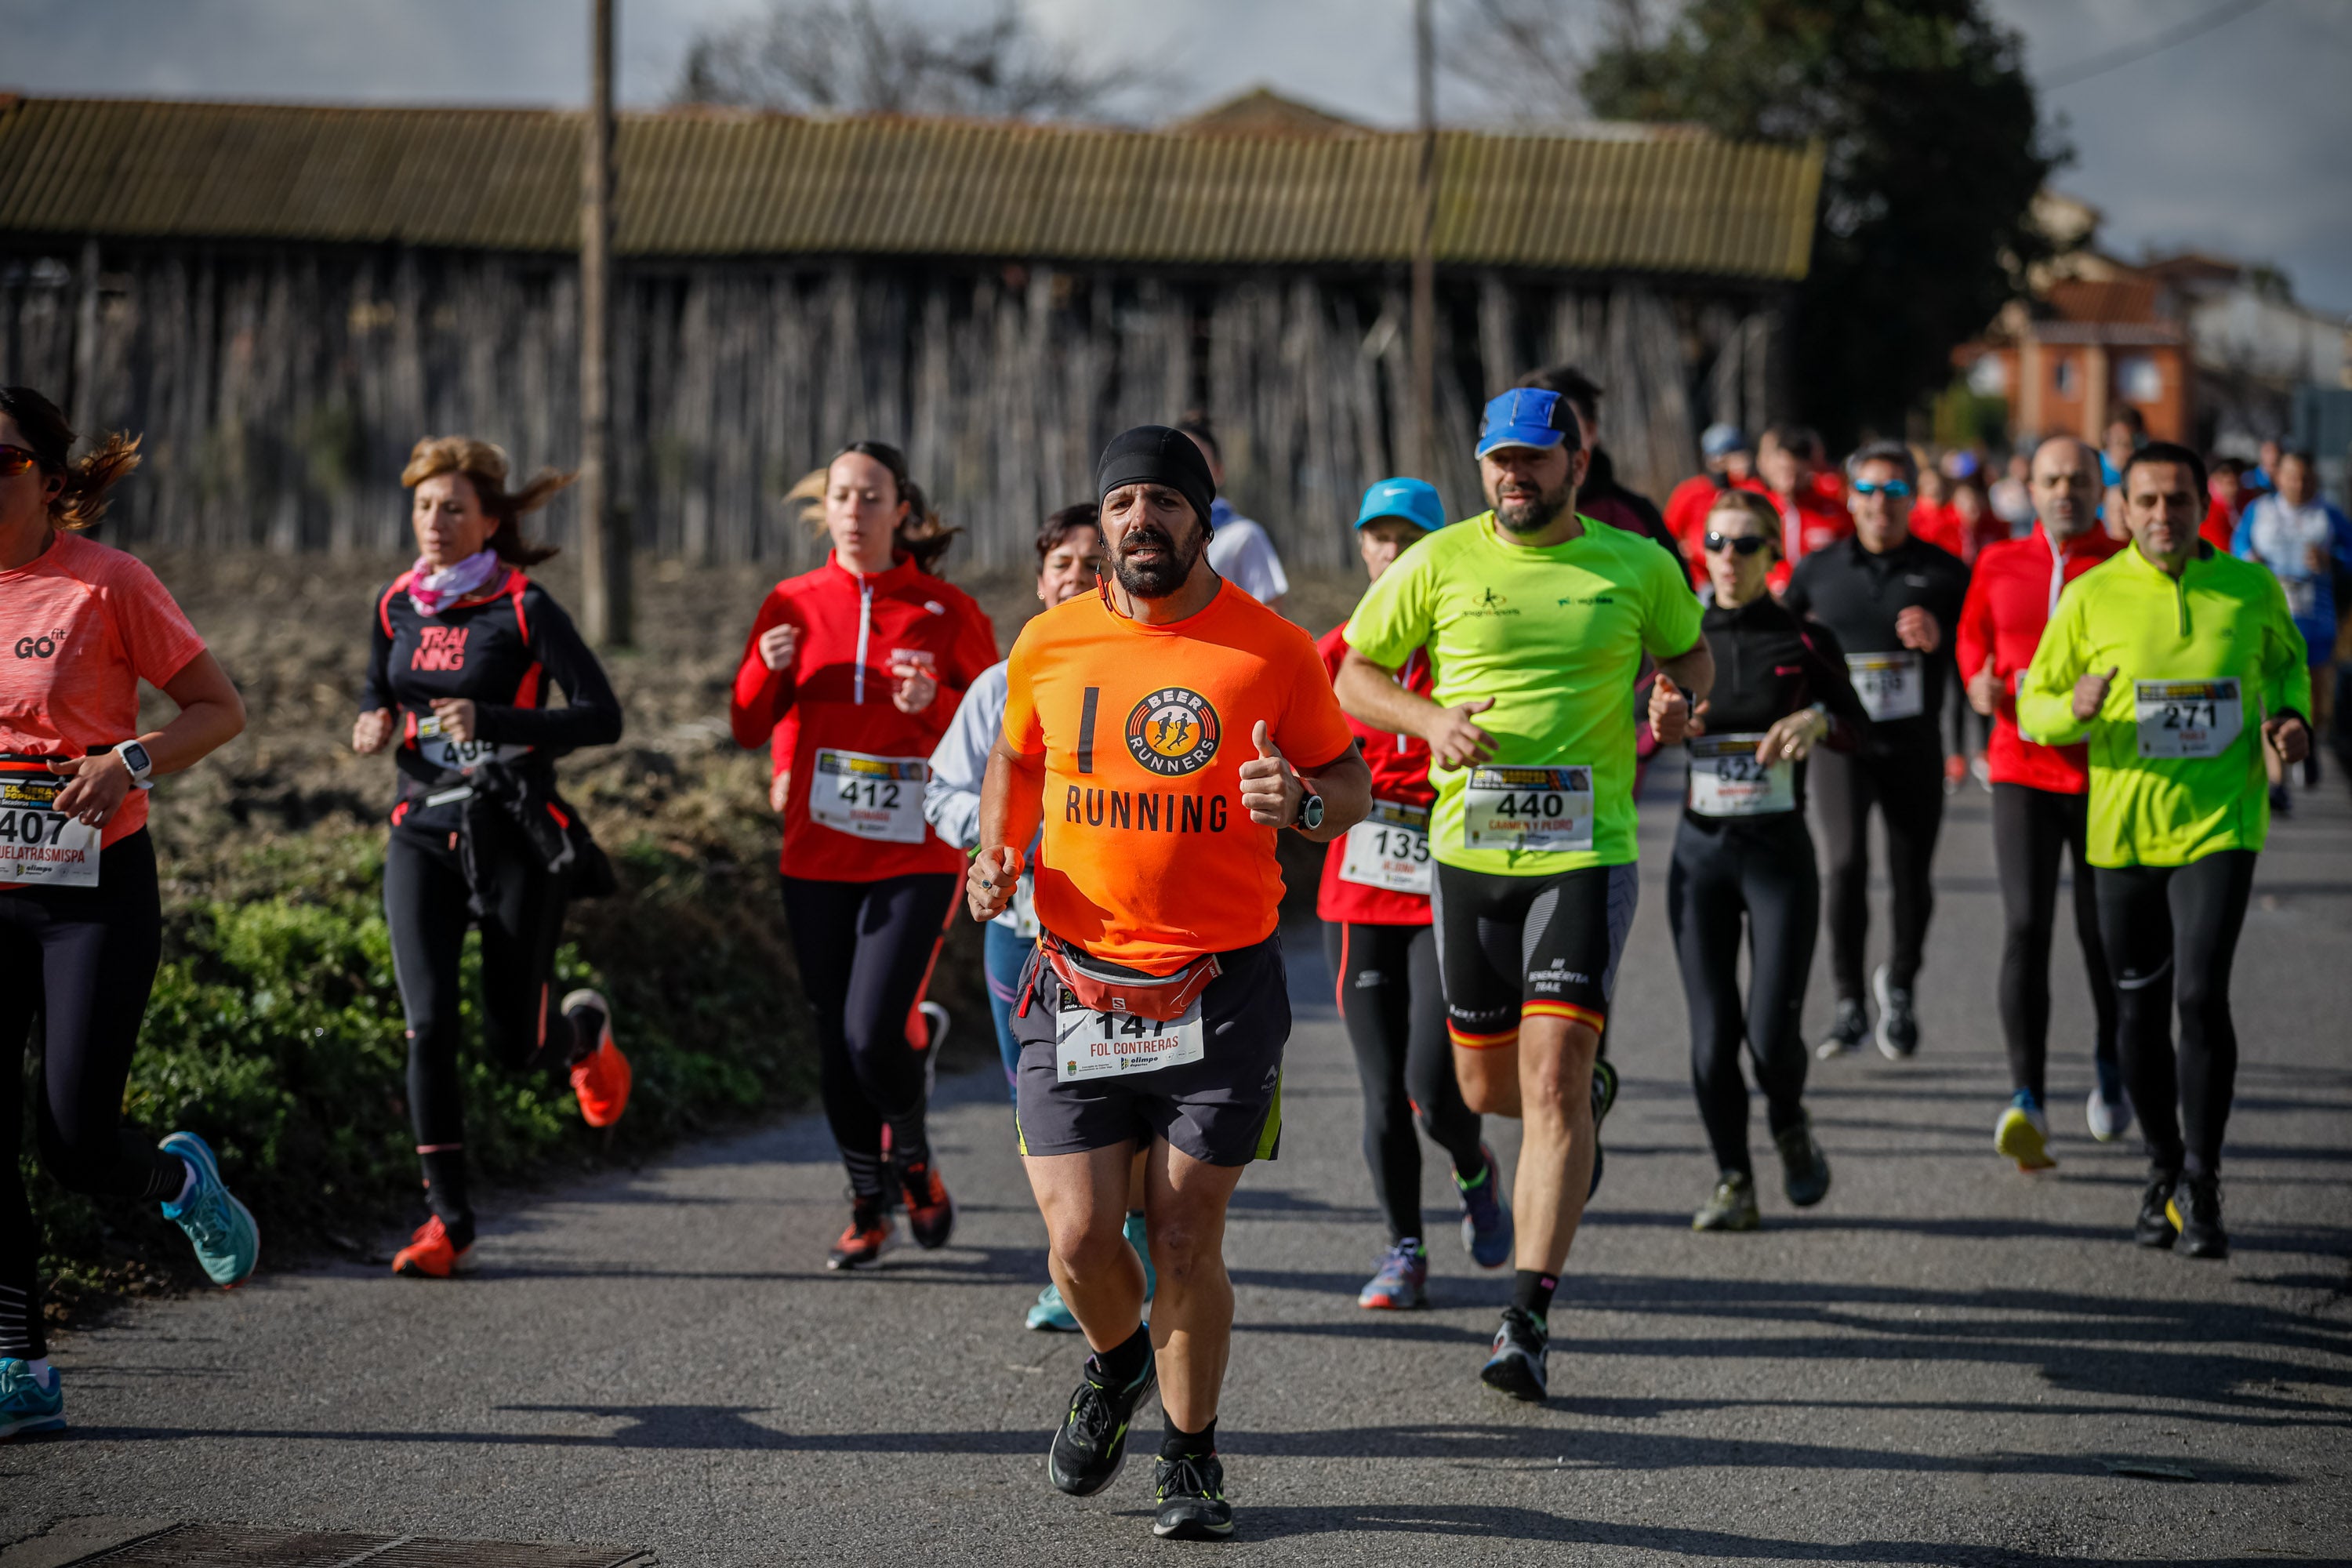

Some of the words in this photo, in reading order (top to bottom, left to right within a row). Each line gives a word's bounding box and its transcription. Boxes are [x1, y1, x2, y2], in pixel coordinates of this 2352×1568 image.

[15, 636, 55, 659] GO
[51, 628, 67, 640] fit
[420, 626, 470, 649] TRAI
[410, 648, 465, 671] NING
[1147, 690, 1203, 711] BEER
[2163, 702, 2216, 729] 271
[1077, 687, 1099, 774] I
[1130, 736, 1214, 772] RUNNERS
[840, 781, 900, 808] 412
[1497, 793, 1563, 818] 440
[1066, 785, 1227, 833] RUNNING
[0, 810, 69, 844] 407
[1376, 830, 1430, 862] 135
[1091, 1043, 1111, 1057] FOL
[1113, 1036, 1178, 1054] CONTRERAS
